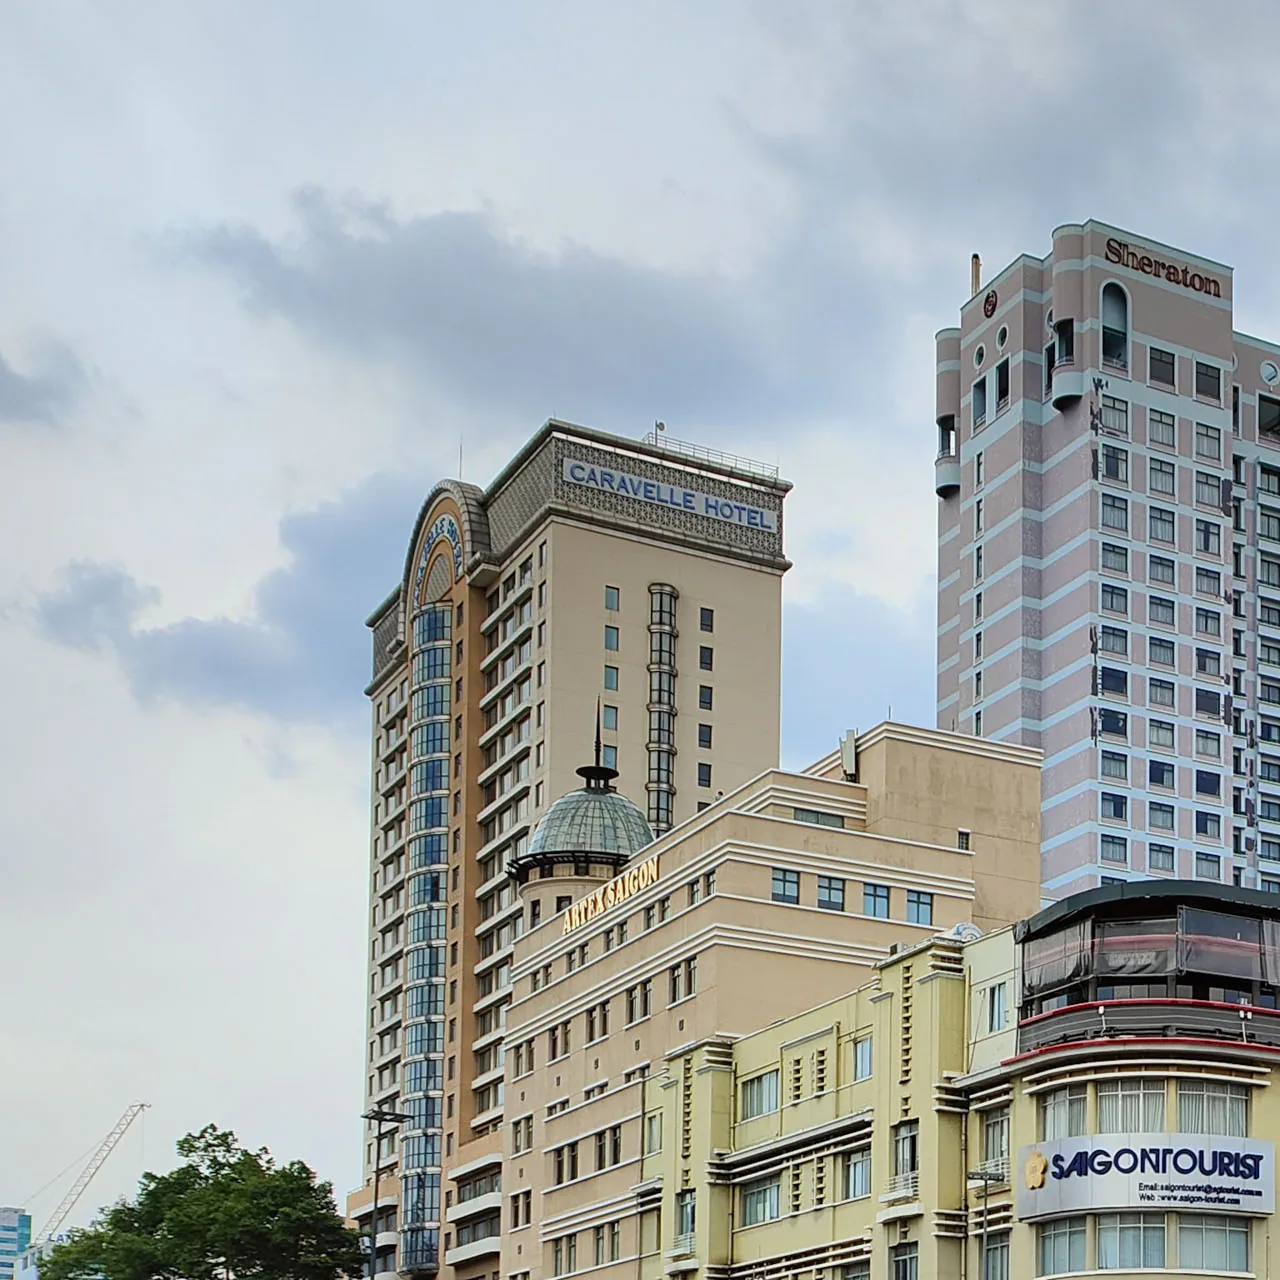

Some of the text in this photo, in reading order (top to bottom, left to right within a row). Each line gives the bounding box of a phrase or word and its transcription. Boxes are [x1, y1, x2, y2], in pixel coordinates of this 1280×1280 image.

[1105, 238, 1221, 298] Sheraton
[570, 463, 772, 530] CARAVELLE HOTEL
[562, 855, 660, 936] ARTEX SAIGON
[1051, 1148, 1264, 1180] SAIGONTOURIST
